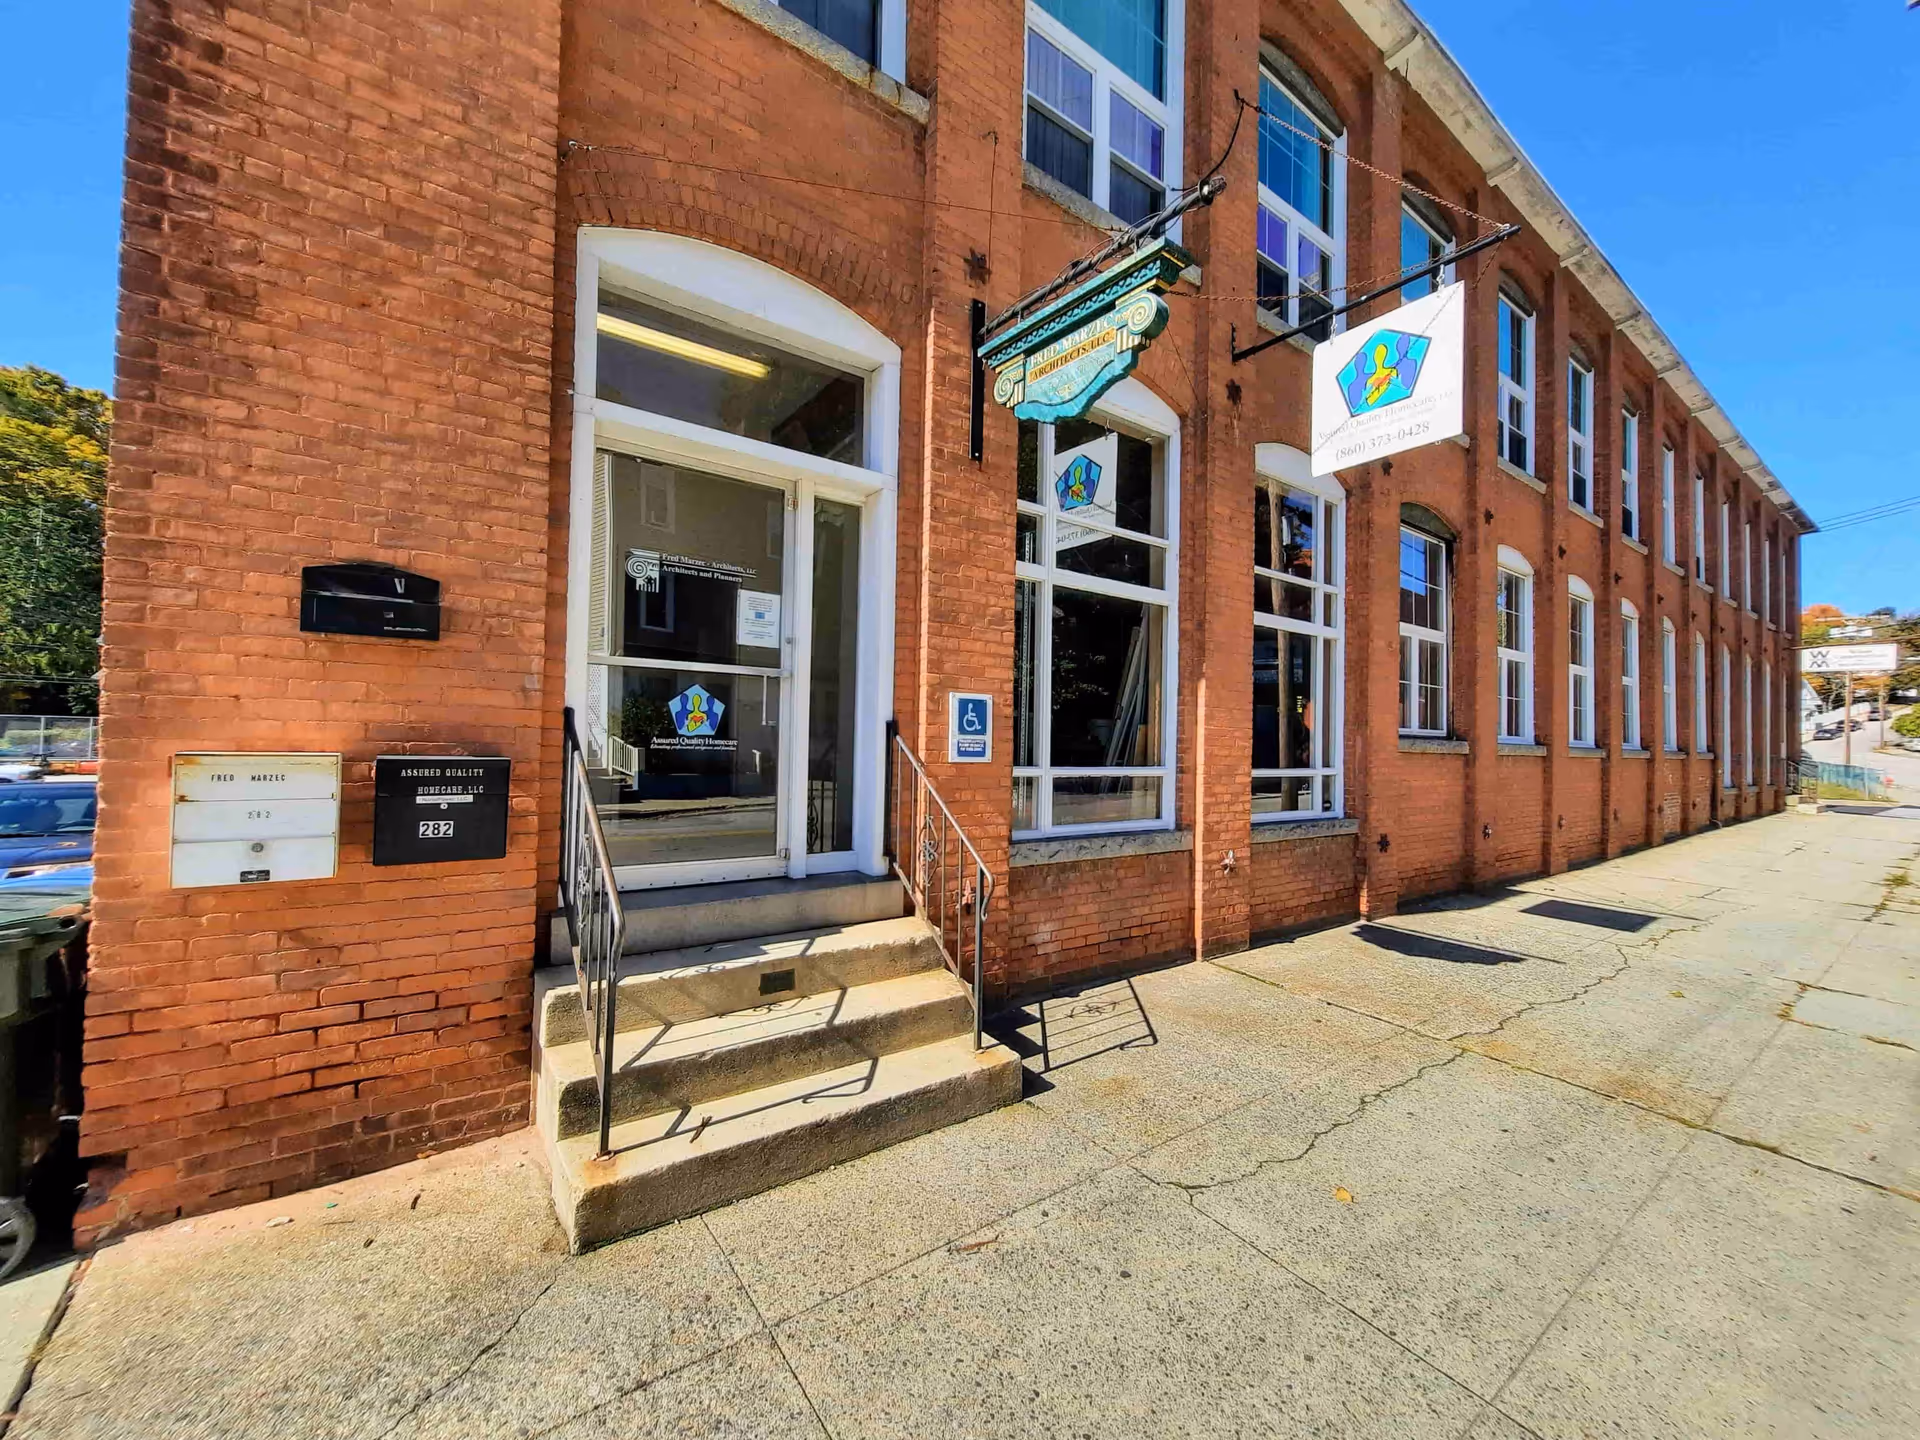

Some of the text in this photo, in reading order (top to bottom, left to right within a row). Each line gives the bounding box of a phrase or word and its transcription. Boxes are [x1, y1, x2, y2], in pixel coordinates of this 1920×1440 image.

[1335, 442, 1366, 461] (860)
[1369, 420, 1431, 448] 373-0428
[662, 553, 680, 562] Fred
[680, 555, 706, 567] Marzec
[711, 561, 746, 574] Architects,
[662, 565, 698, 577] Architects
[714, 573, 743, 583] Planners
[651, 736, 738, 747] Assured Quality Homecare
[211, 774, 286, 782] FRED MARZEC
[400, 768, 485, 777] ASSURED QUALITY
[420, 822, 453, 837] 282
